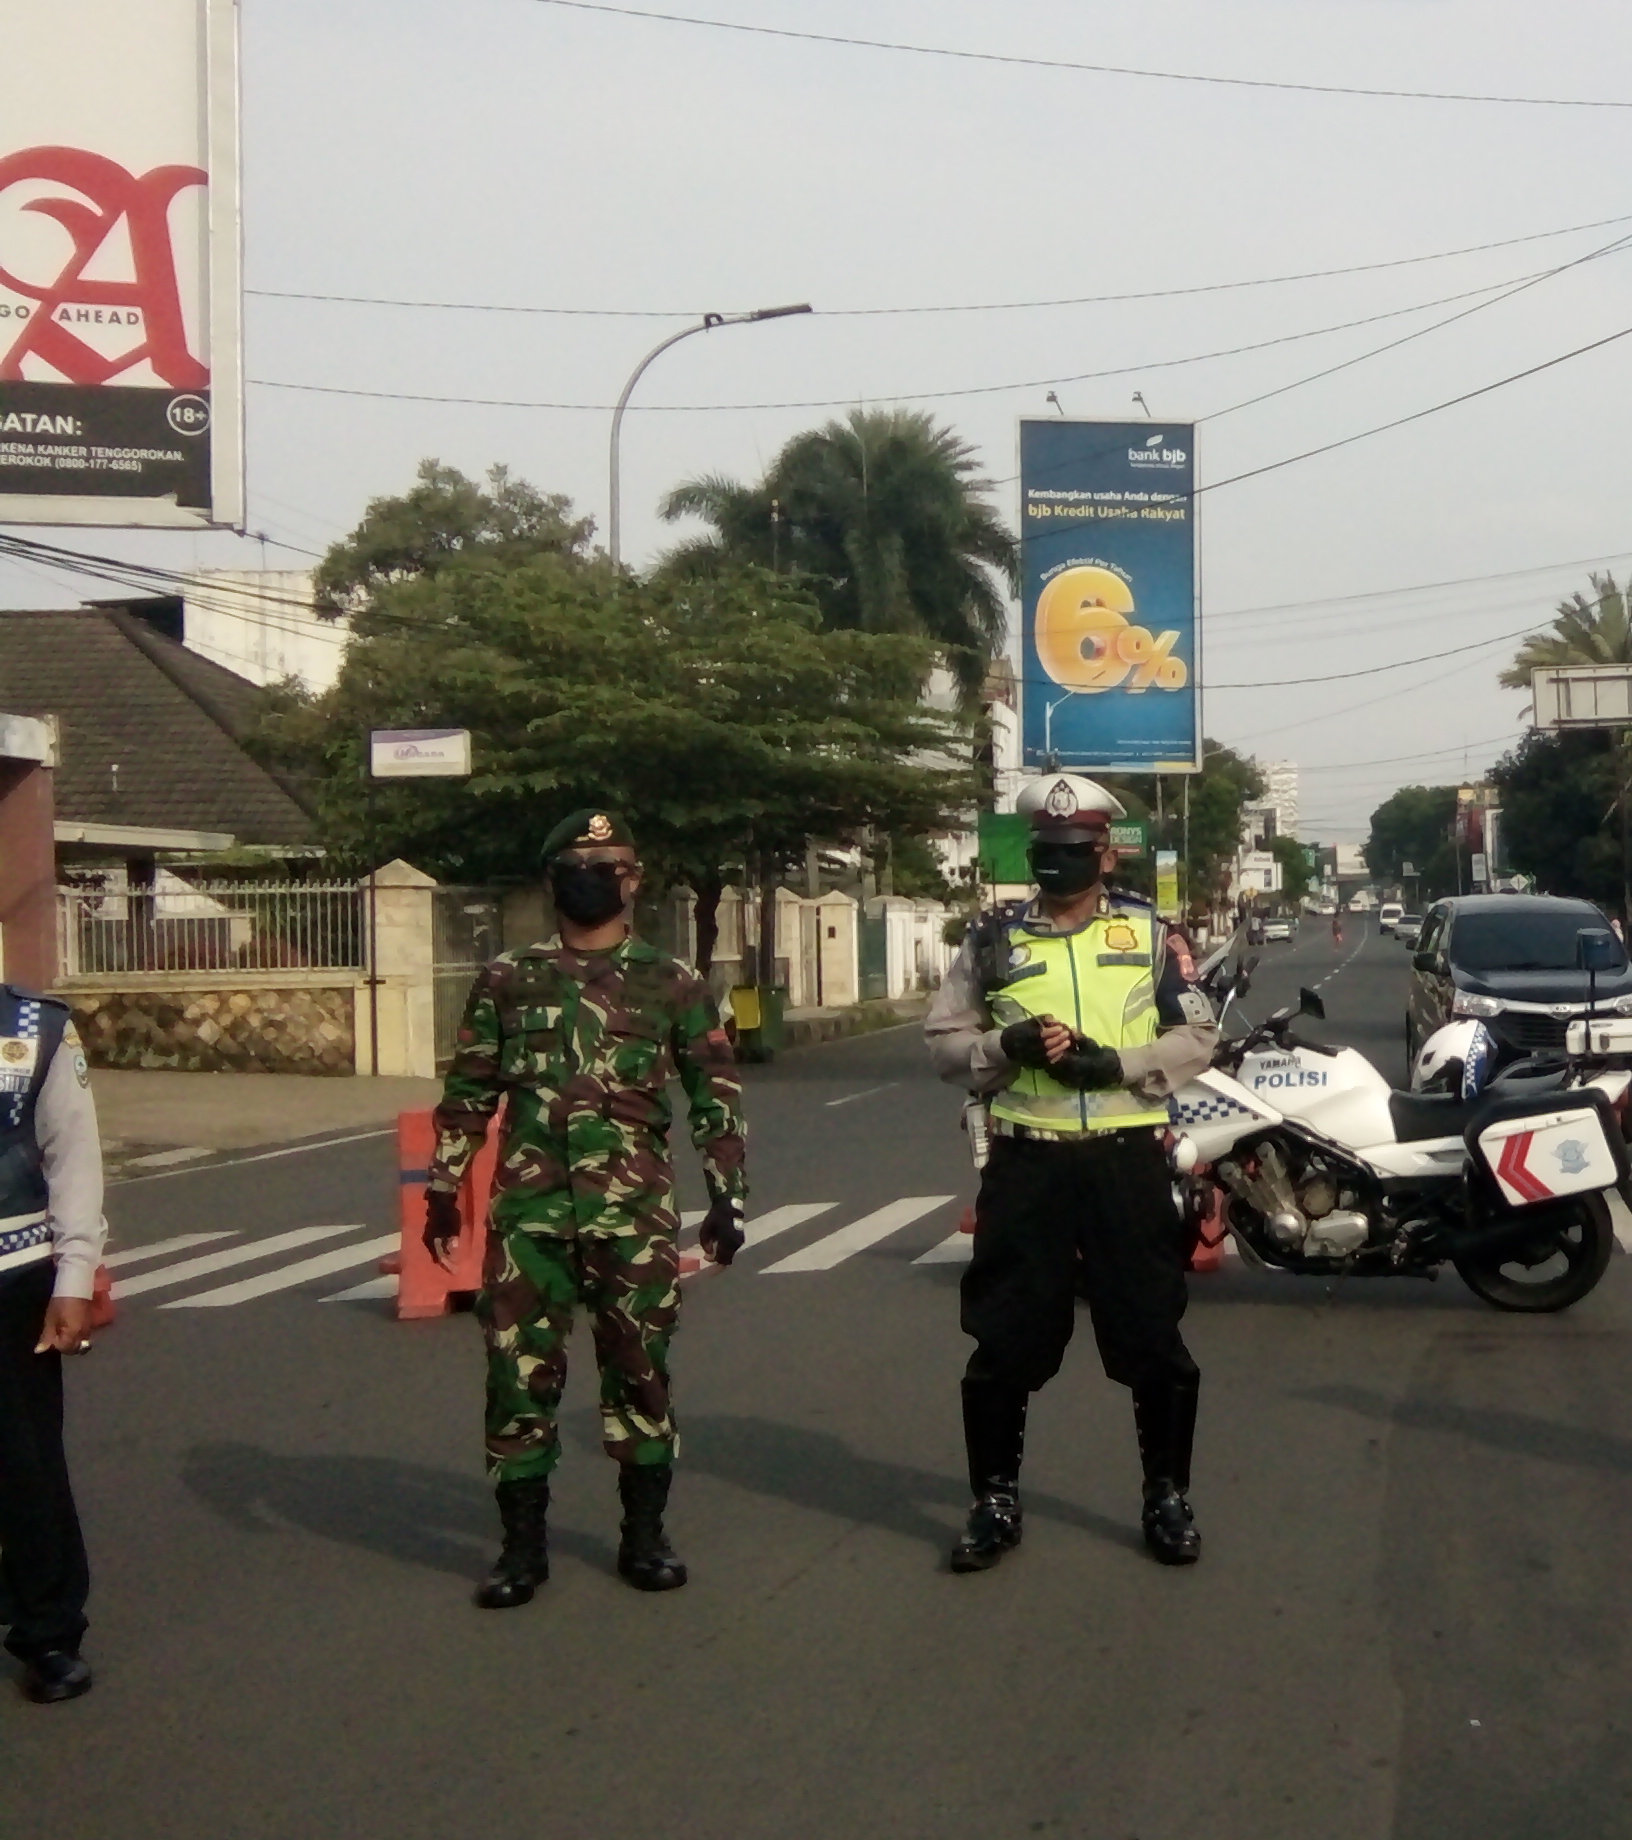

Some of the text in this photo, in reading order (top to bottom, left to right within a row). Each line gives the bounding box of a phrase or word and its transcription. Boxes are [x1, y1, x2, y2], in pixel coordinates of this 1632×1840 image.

[0, 304, 140, 326] GO AHEAD
[172, 407, 207, 423] 18+
[0, 412, 82, 436] ATAN:
[37, 445, 87, 458] KANKER
[1128, 447, 1187, 464] bank bjb
[1028, 489, 1091, 501] Kembangkan
[1093, 490, 1122, 501] usaha
[1124, 490, 1149, 502] Anda
[1028, 504, 1051, 518] bjb
[1054, 504, 1095, 518] Kredit
[1141, 507, 1185, 521] Rakyat
[1254, 1071, 1327, 1090] POLISI
